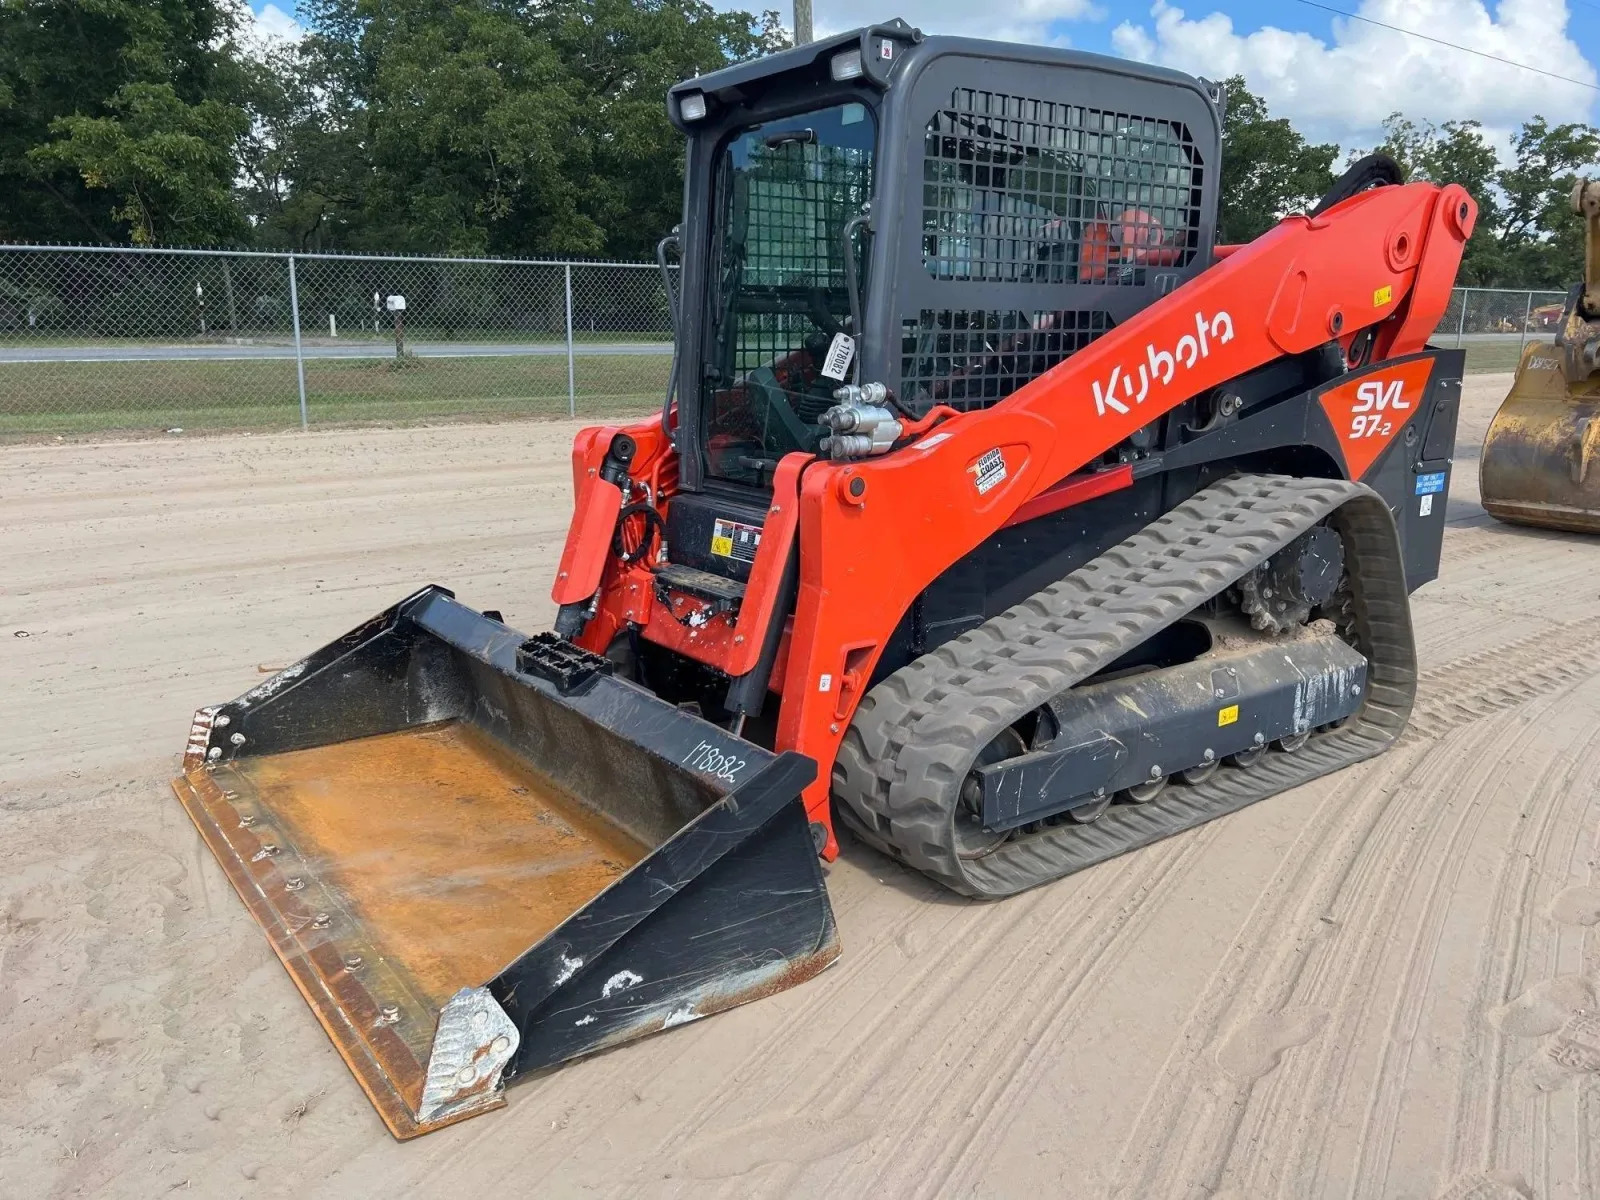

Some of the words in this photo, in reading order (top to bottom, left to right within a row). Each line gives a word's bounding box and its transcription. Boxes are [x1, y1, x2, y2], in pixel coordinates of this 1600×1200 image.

[831, 344, 851, 375] 178082
[1092, 311, 1234, 417] Kubota
[1351, 380, 1410, 413] SVL
[1348, 414, 1392, 439] 97-2
[978, 448, 1000, 468] FLORIDA
[980, 455, 1002, 476] COAST
[682, 740, 746, 783] 178082
